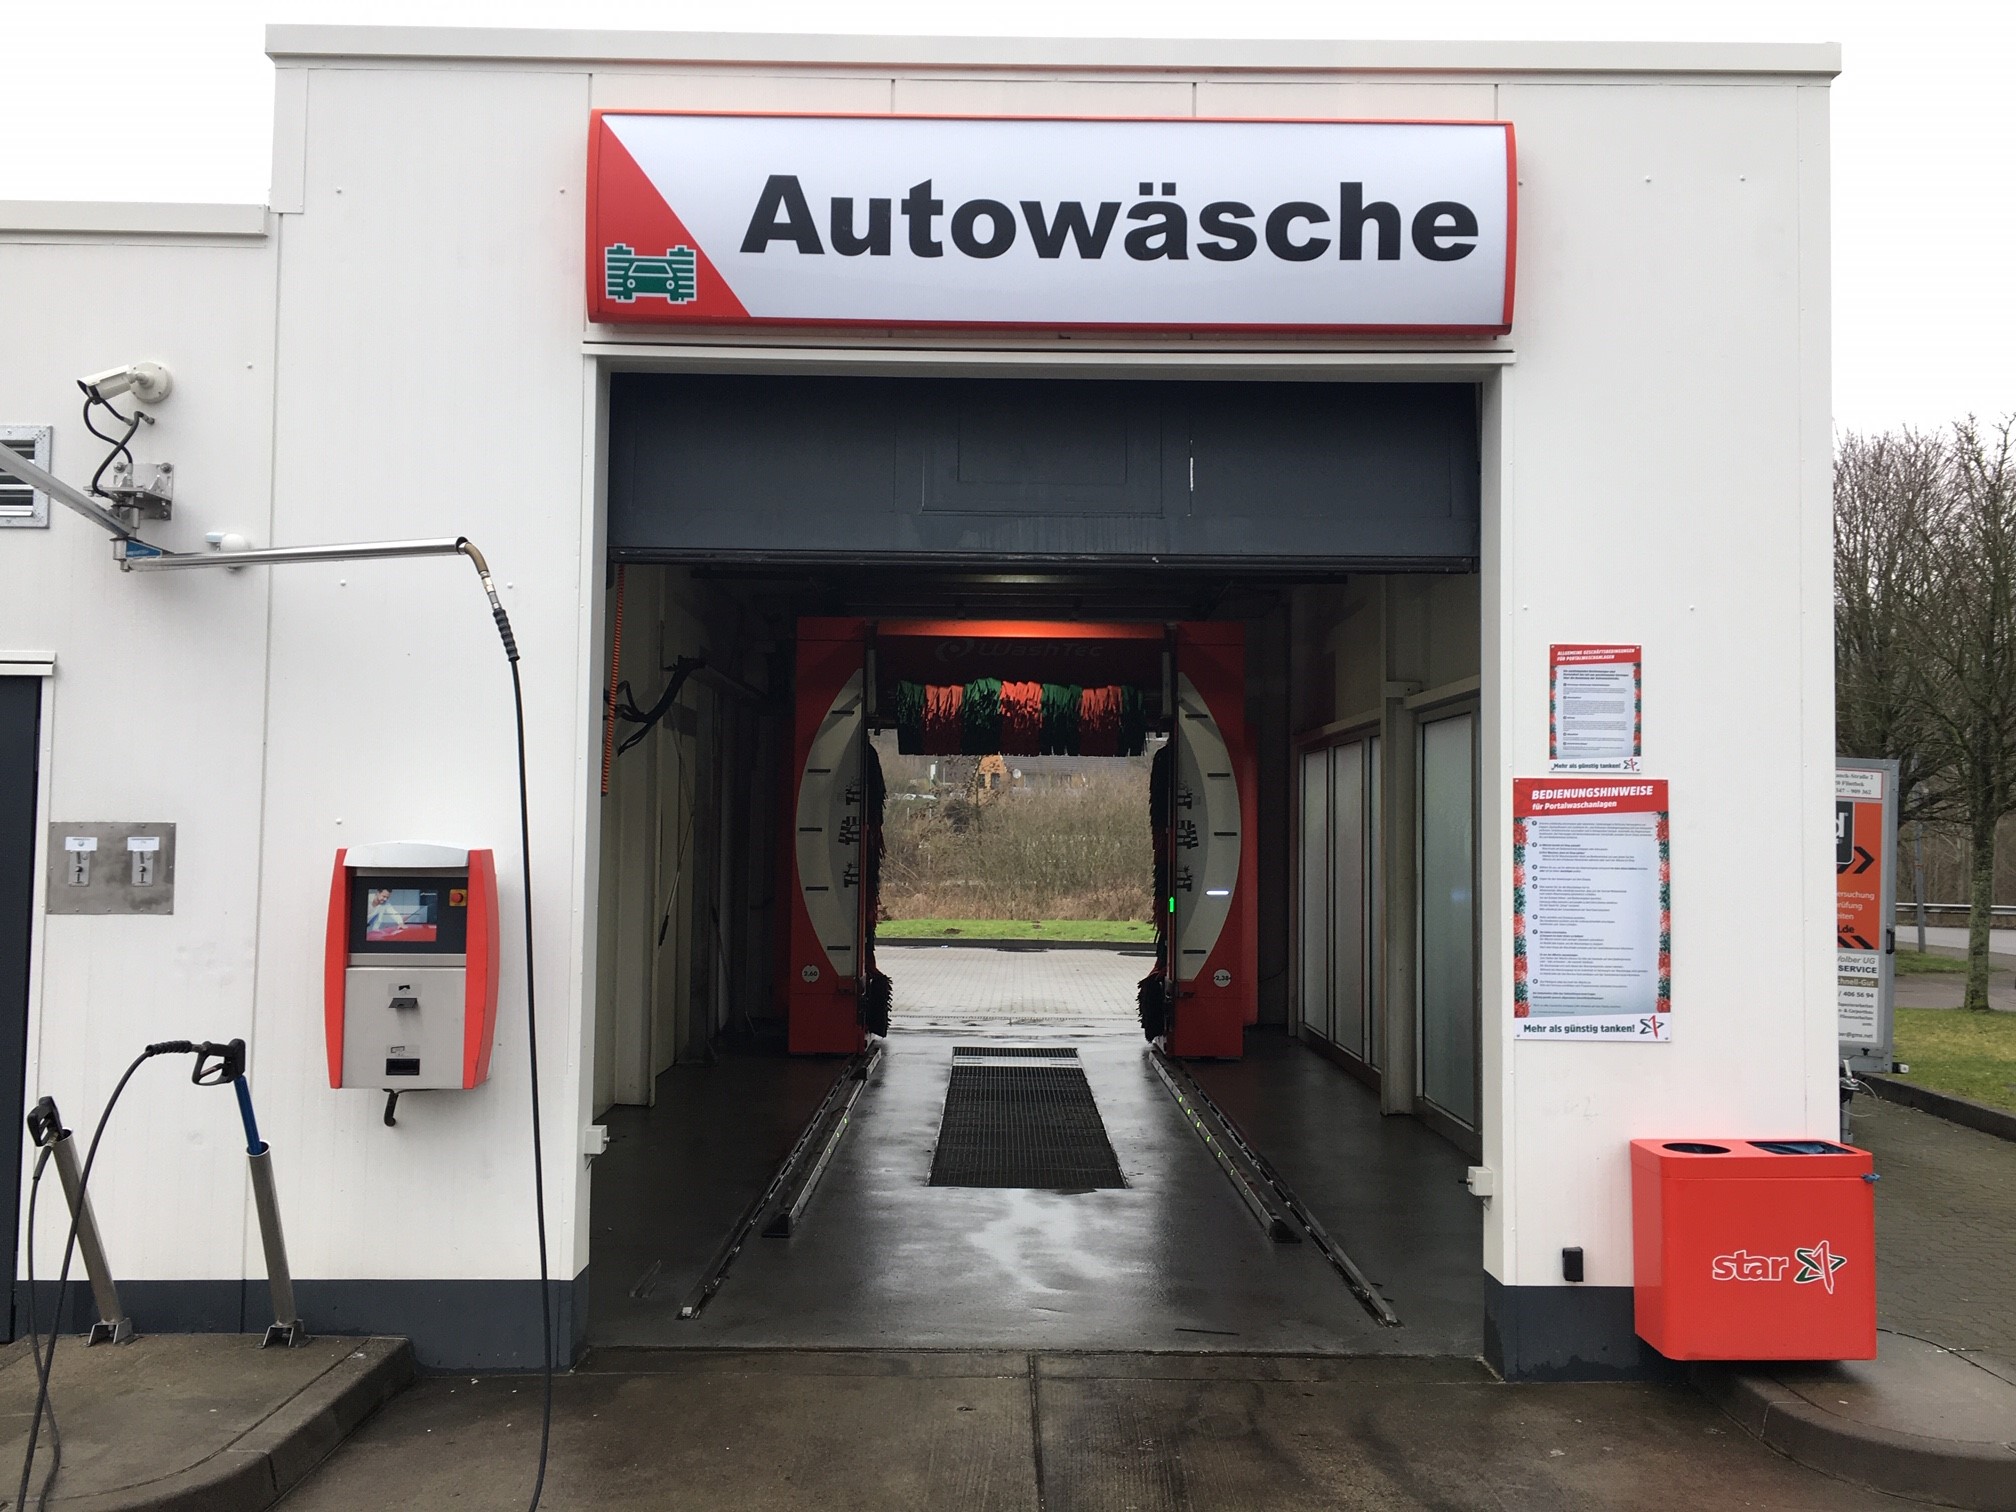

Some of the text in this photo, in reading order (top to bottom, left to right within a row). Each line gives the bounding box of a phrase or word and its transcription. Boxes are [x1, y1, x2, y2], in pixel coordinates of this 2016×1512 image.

[739, 174, 1480, 263] Autowäsche
[977, 642, 1104, 657] WashTec
[1532, 785, 1654, 800] BEDIENUNGSHINWEISE
[1532, 800, 1617, 811] für Portalwaschanlagen
[1838, 965, 1878, 973] SERVICE
[1523, 1023, 1636, 1036] Mehr als günstig tanken!
[1712, 1249, 1790, 1282] star
